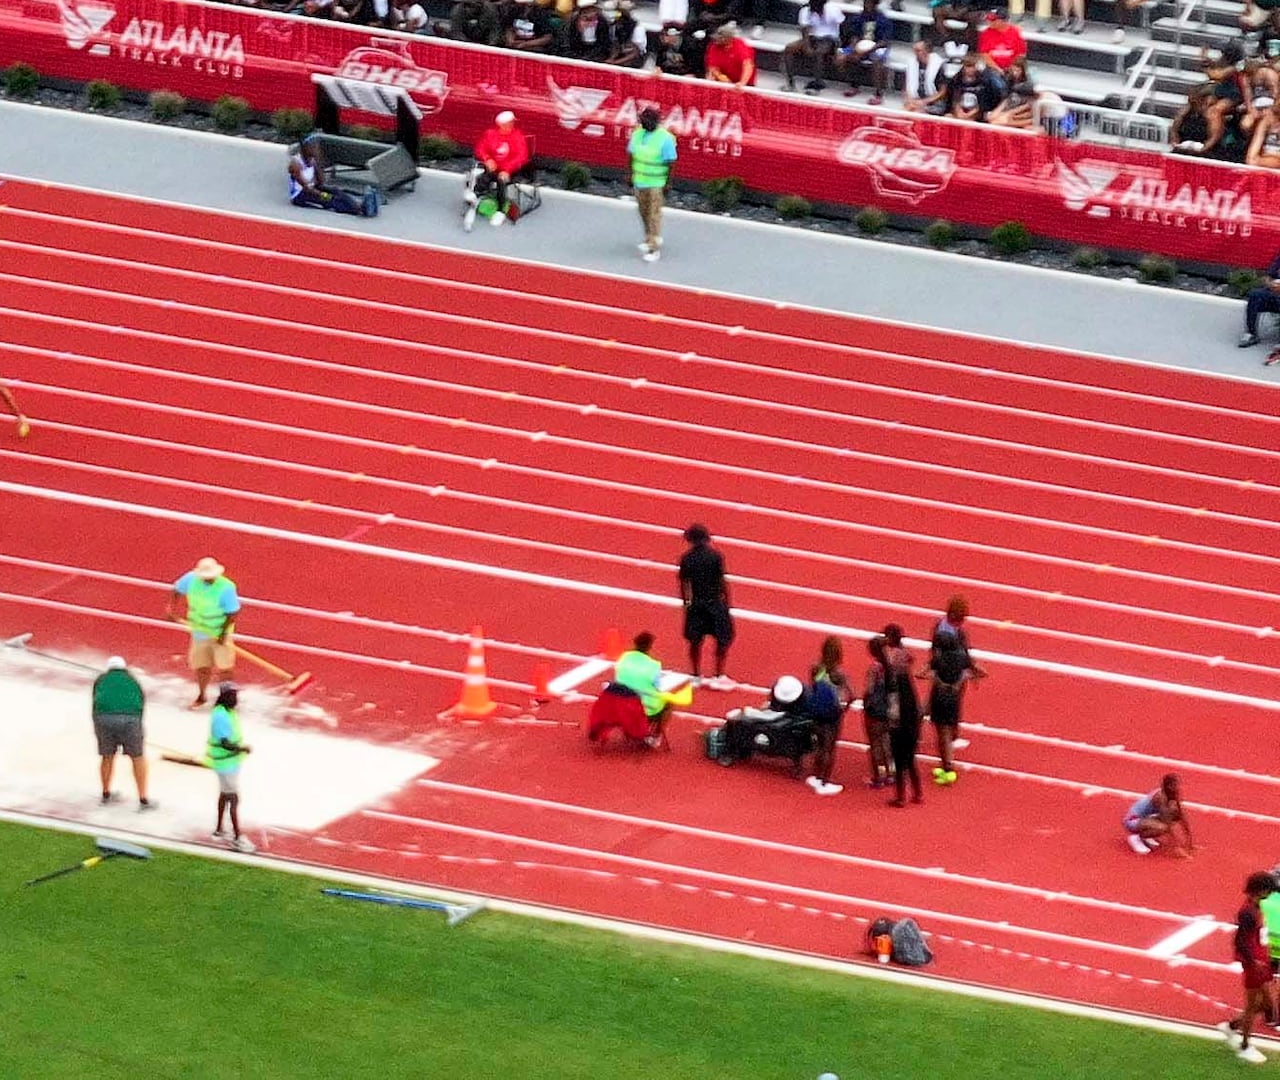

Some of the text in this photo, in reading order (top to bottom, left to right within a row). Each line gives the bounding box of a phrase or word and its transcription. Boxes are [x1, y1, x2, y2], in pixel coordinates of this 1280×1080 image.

[117, 17, 246, 65] ATLANTA
[119, 45, 245, 80] TRACK CLUB
[615, 96, 744, 143] AANTA
[690, 137, 743, 157] CLUB
[1119, 176, 1252, 221] ATLANTA
